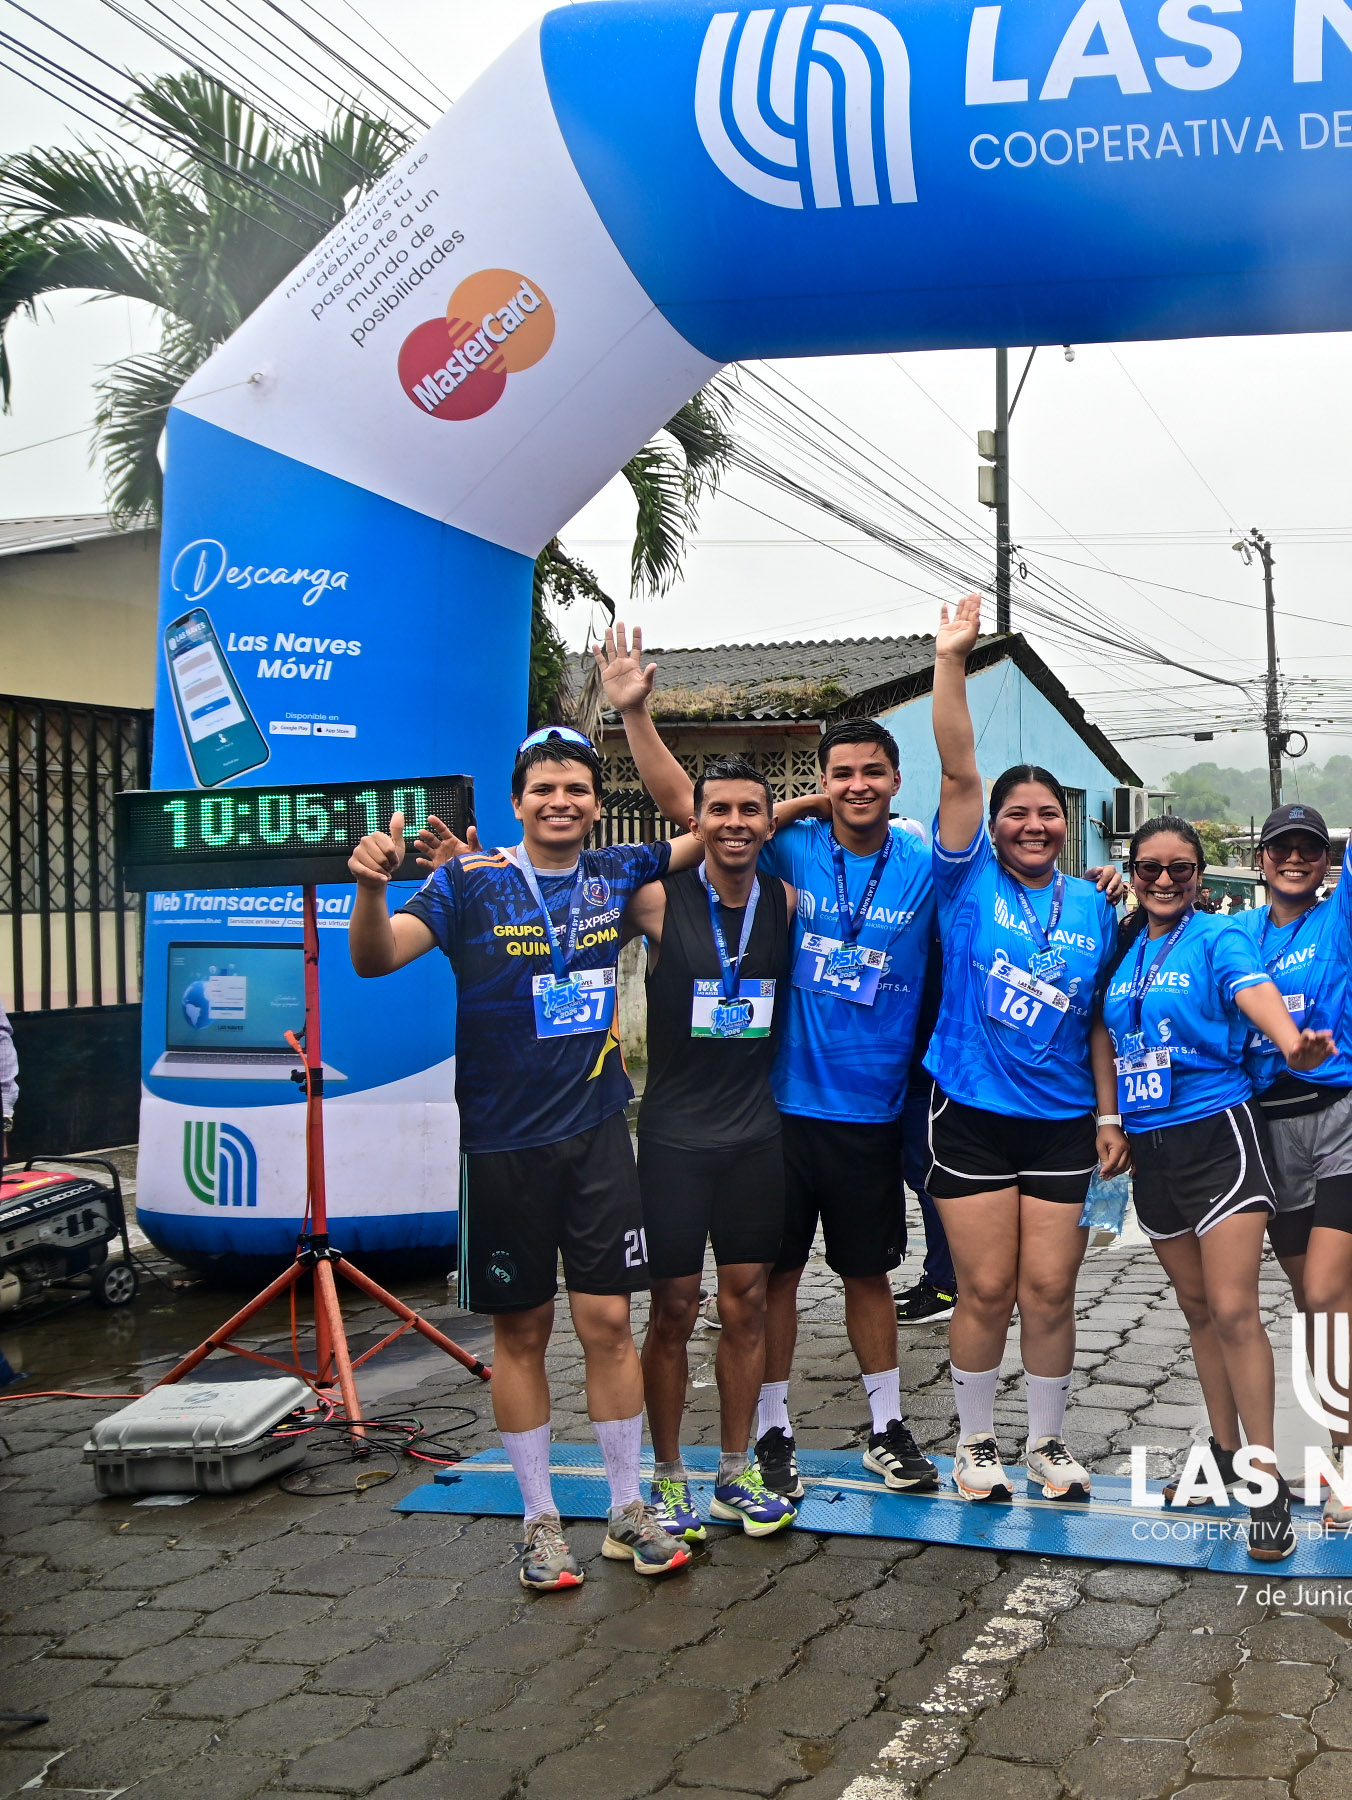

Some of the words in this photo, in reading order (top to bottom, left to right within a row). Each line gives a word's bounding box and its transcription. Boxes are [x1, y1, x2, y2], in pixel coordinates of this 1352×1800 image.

[964, 0, 1243, 105] LAS
[969, 115, 1284, 170] COOPERATIVA
[286, 235, 347, 299] nuestra
[350, 178, 404, 233] tarjeta
[407, 153, 429, 175] de
[316, 233, 369, 287] débito
[372, 209, 392, 230] es
[394, 188, 413, 208] tu
[310, 229, 398, 321] pasaporte
[400, 213, 414, 228] a
[415, 189, 440, 213] un
[346, 249, 409, 312] mundo
[411, 224, 435, 249] de
[350, 230, 465, 348] posibilidades
[412, 279, 542, 412] MasterCard
[171, 538, 349, 606] Descarga
[227, 632, 269, 651] Las
[274, 632, 362, 656] Naves
[257, 656, 333, 681] Móvil
[285, 712, 327, 721] Disponible
[163, 786, 428, 848] 10:05:10
[153, 892, 181, 912] Web
[493, 925, 544, 937] GRUPO
[578, 908, 621, 931] EXPRESS
[506, 927, 619, 956] QUINLOMA
[838, 949, 866, 967] 5K
[1272, 944, 1316, 973] NAVE
[725, 1003, 751, 1024] 10K
[1000, 986, 1043, 1027] 161
[1125, 1072, 1163, 1102] 248
